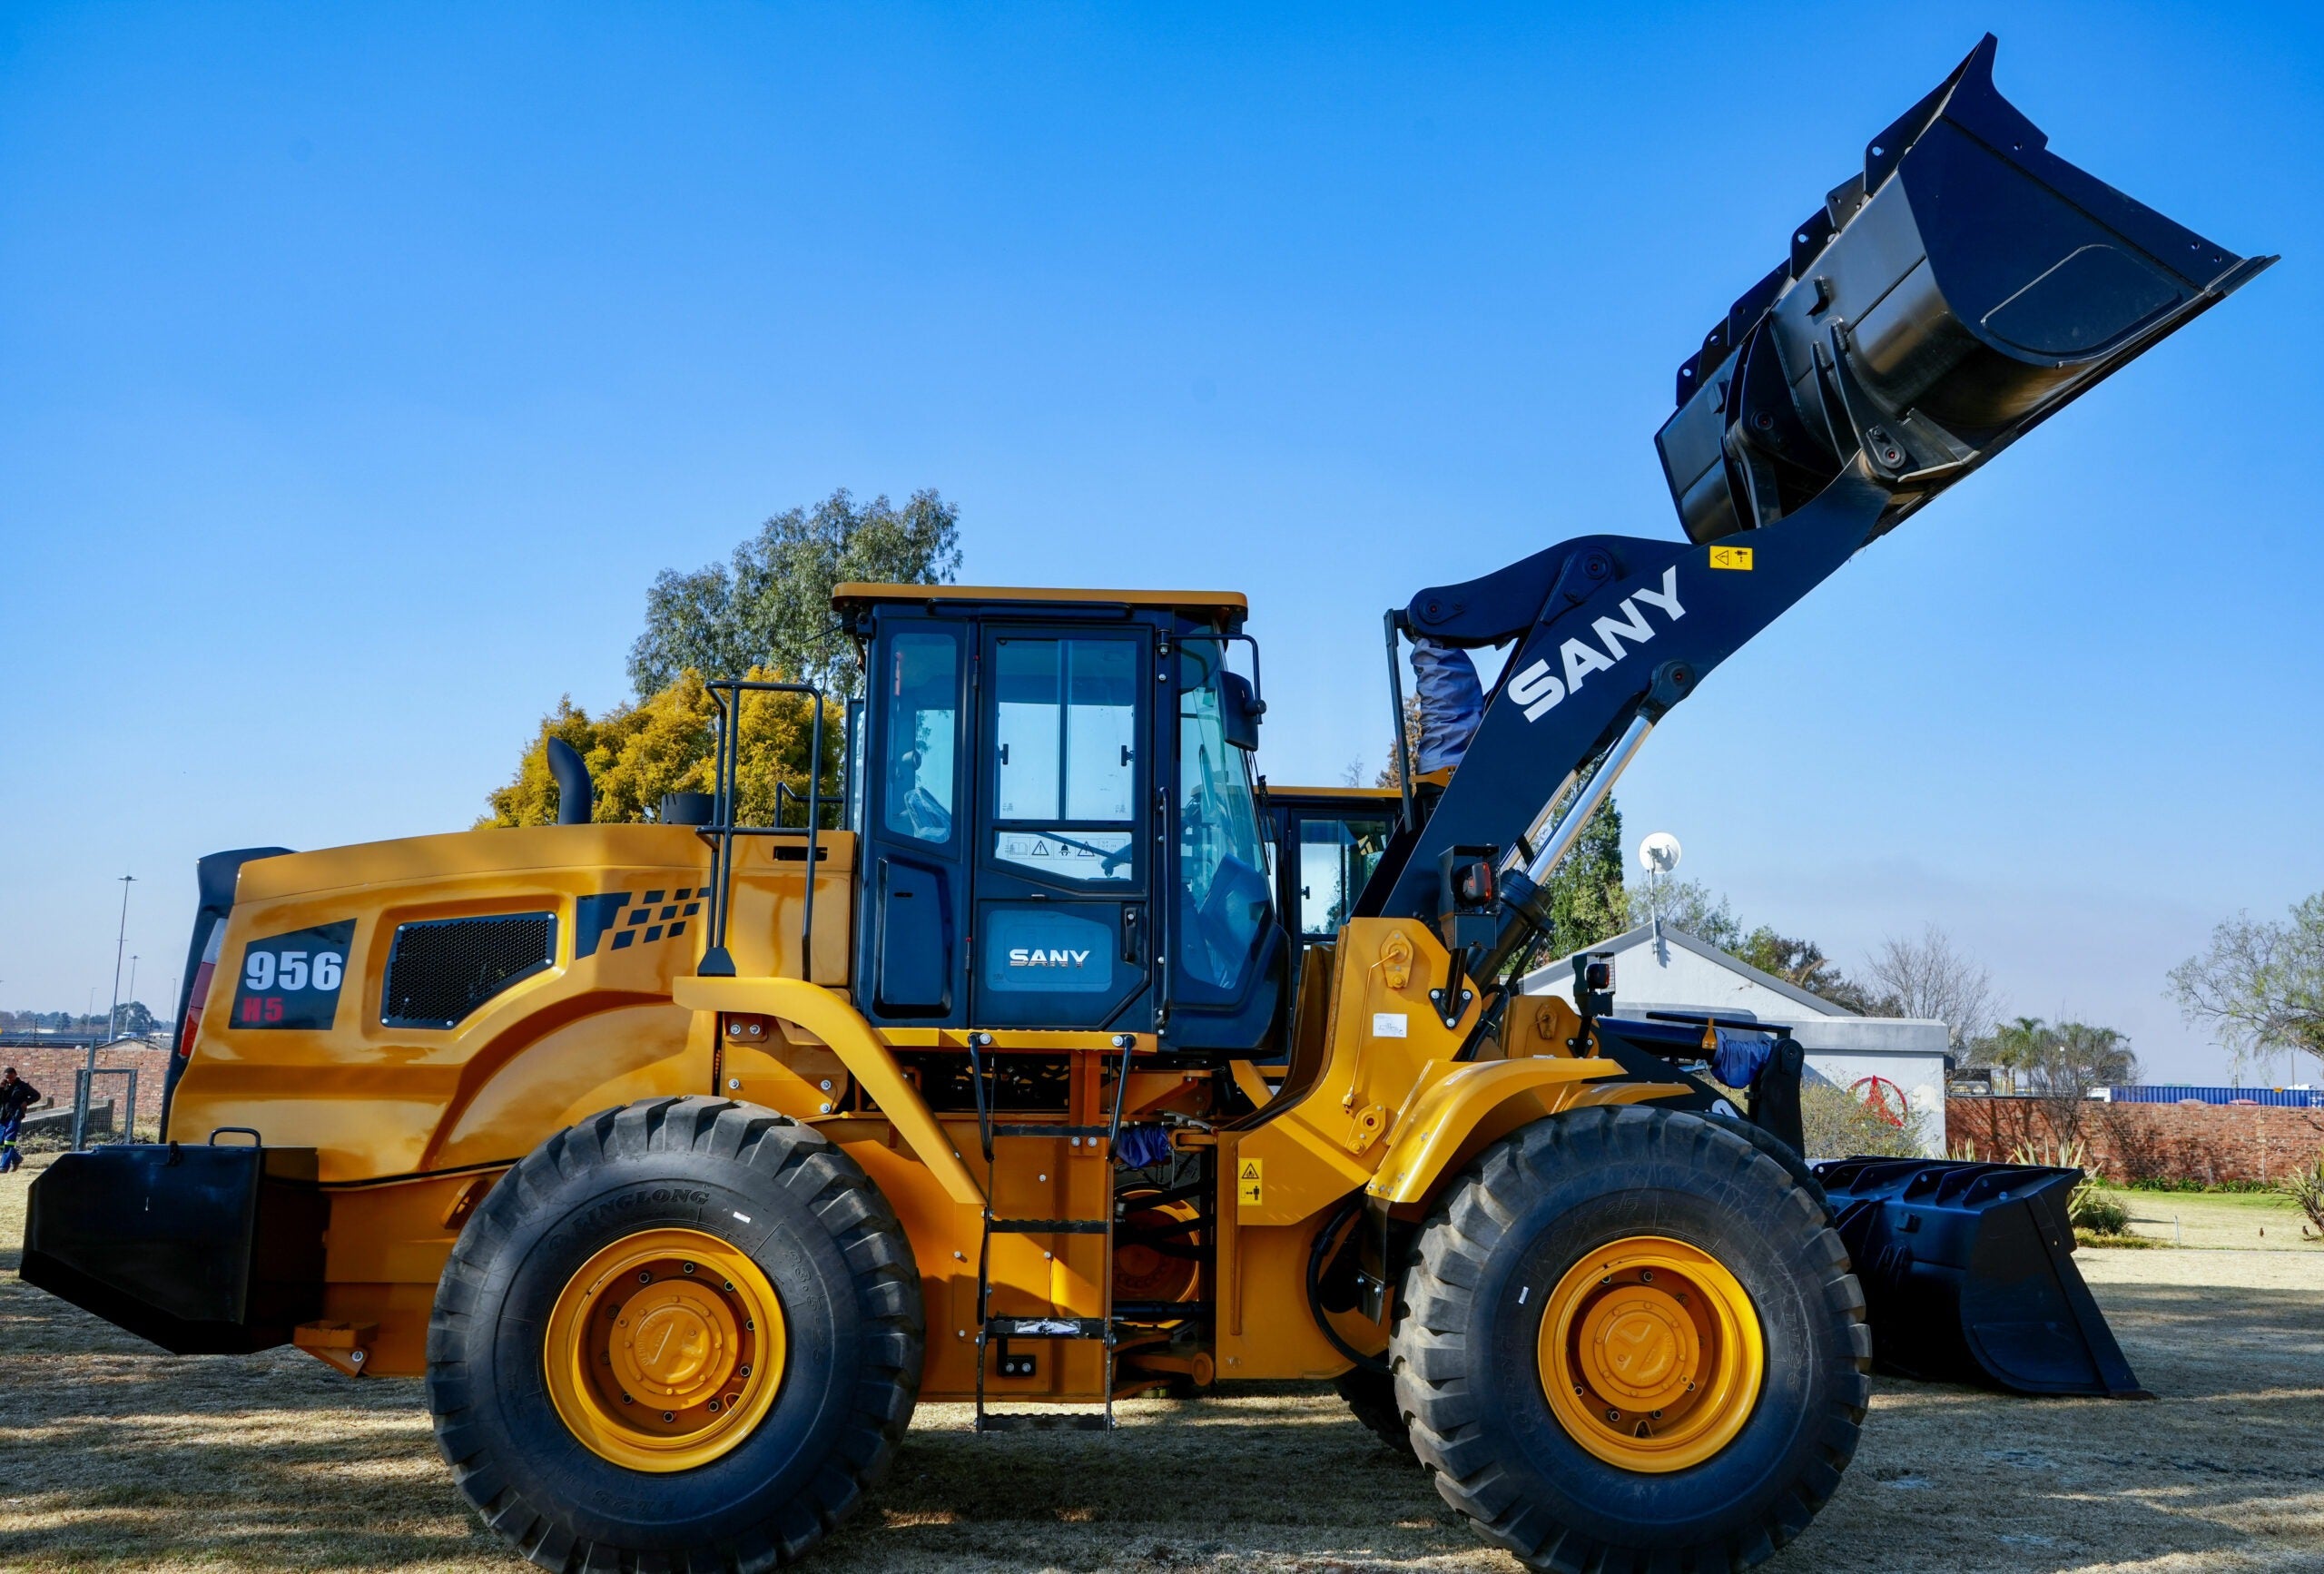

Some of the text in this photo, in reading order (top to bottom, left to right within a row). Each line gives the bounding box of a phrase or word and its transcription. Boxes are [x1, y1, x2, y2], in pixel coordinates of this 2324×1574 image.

[1508, 565, 1686, 723] SANY
[246, 951, 342, 990] 956
[1009, 949, 1090, 967] SANY
[241, 997, 283, 1022] H5
[572, 1188, 710, 1231] LINGLONG
